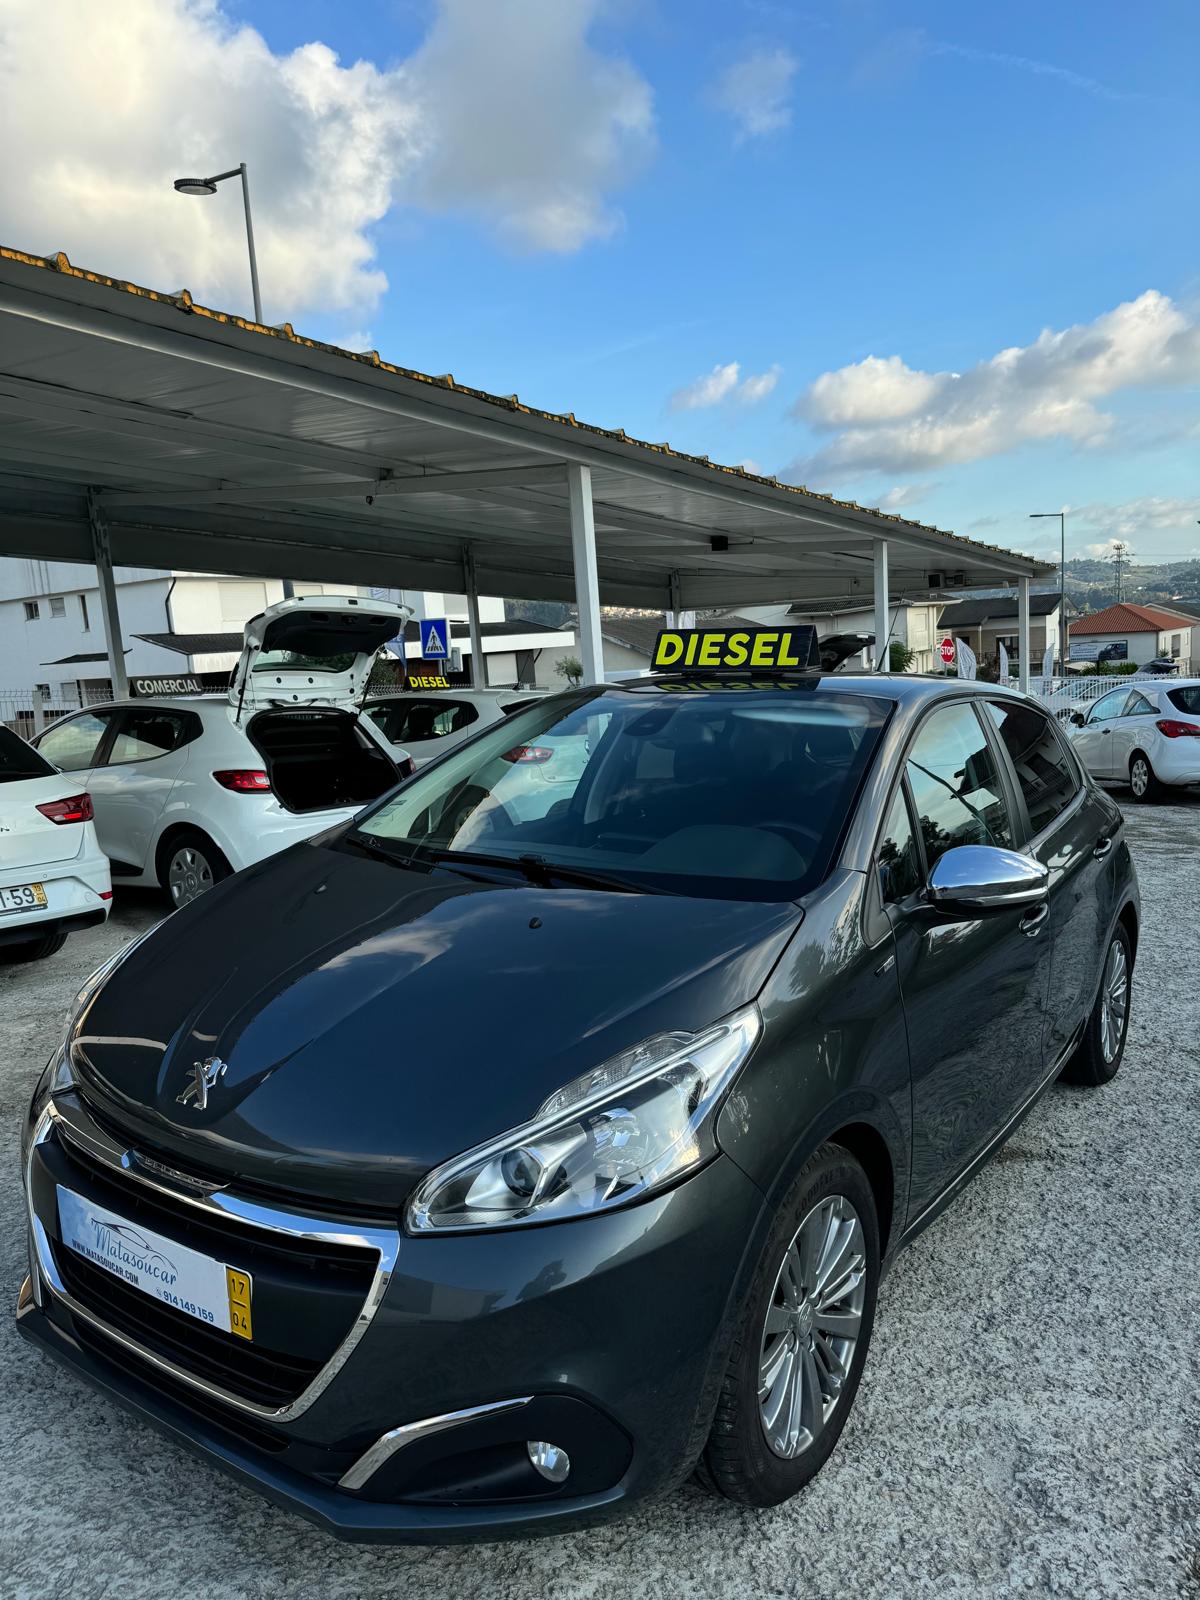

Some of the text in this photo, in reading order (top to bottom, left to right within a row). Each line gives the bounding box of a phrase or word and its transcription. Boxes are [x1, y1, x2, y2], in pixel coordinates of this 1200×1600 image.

[655, 632, 800, 666] DIESEL
[941, 646, 955, 656] STOP
[137, 679, 202, 693] COMERCIAL
[408, 676, 450, 688] DIESEL
[71, 1239, 140, 1286] WWW.MATASOUCAR.COM
[91, 1220, 177, 1286] Matasoucar
[231, 1277, 246, 1296] 17
[163, 1291, 214, 1323] 914 149 159
[232, 1312, 247, 1331] 04
